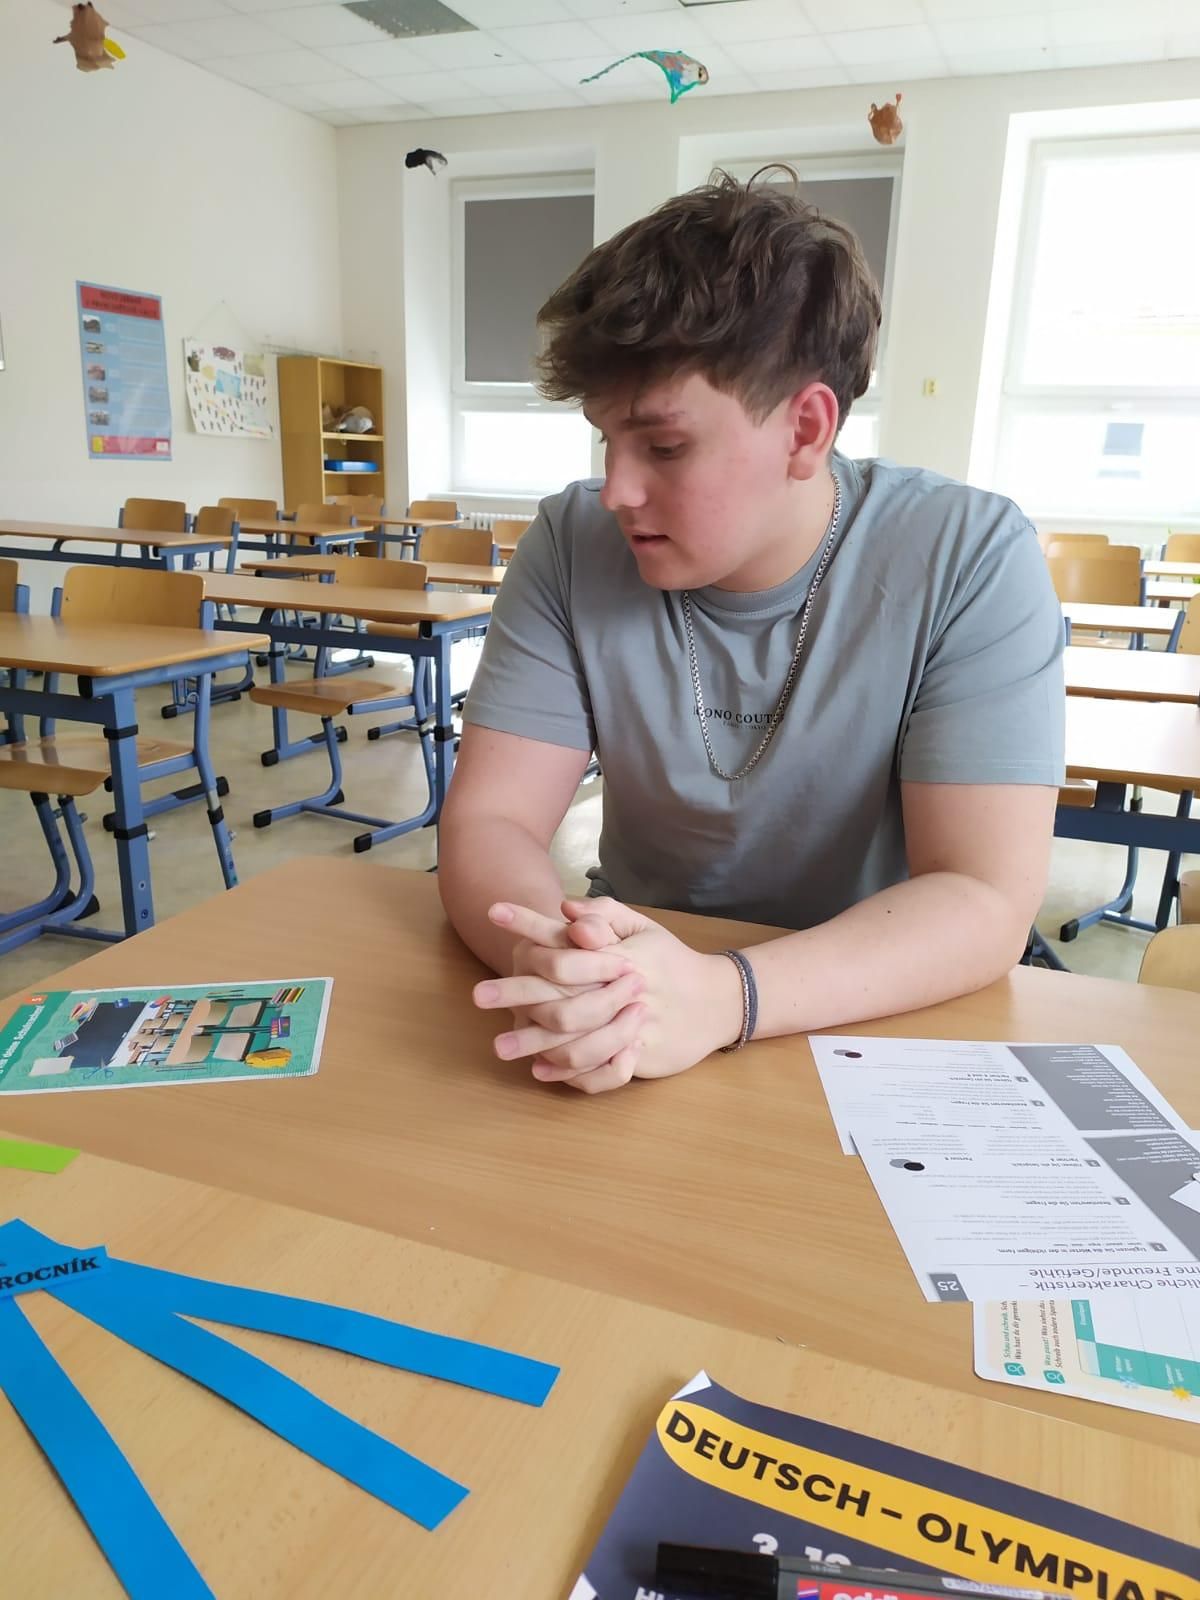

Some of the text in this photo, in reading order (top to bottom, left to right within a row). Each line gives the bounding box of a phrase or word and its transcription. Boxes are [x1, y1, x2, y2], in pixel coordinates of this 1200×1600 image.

[1028, 1266, 1173, 1279] Freunde/Gefühle
[937, 1280, 960, 1291] 25
[1034, 1279, 1154, 1292] Charakteristik
[1156, 1279, 1200, 1289] liche
[665, 1410, 871, 1517] DEUTSCH
